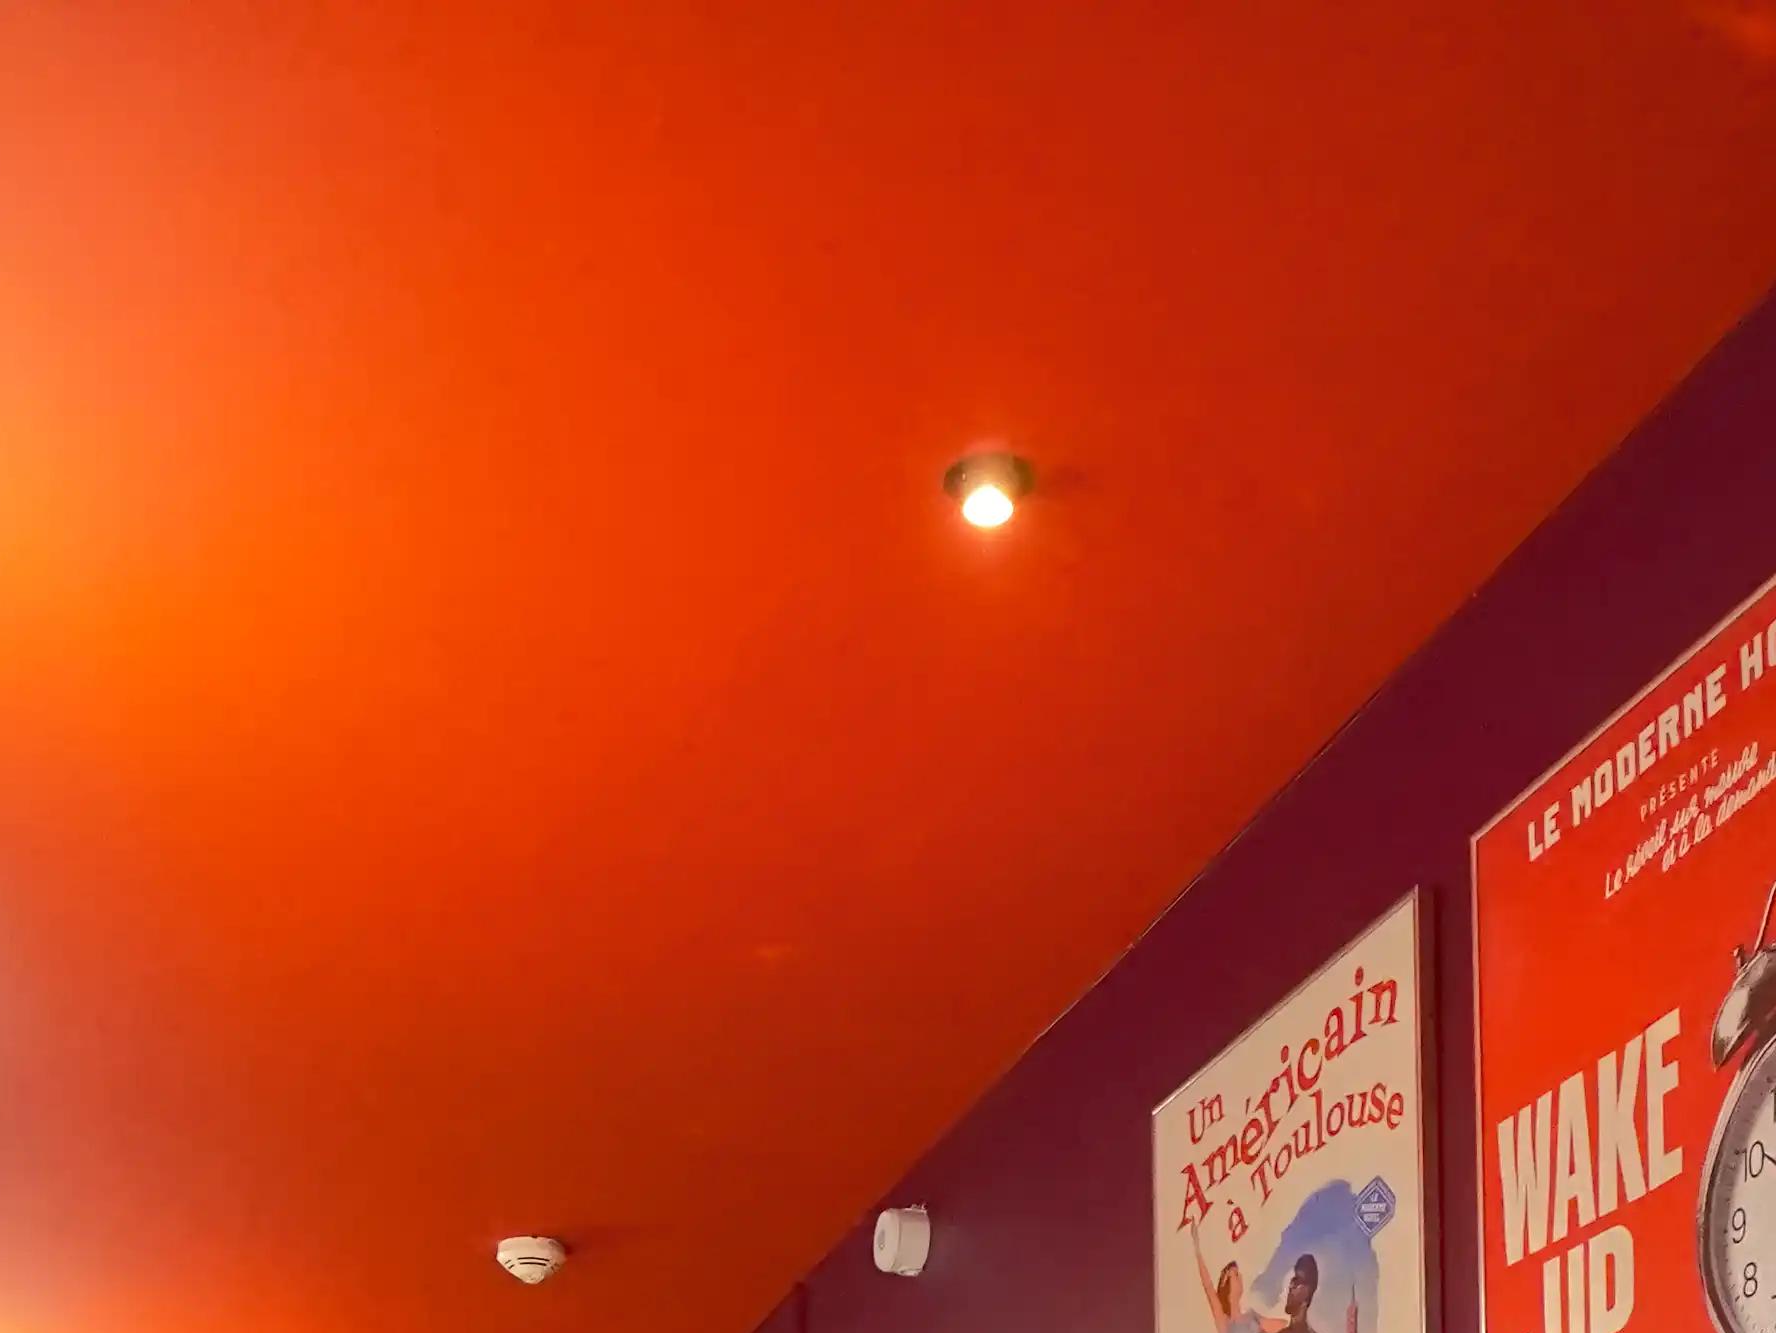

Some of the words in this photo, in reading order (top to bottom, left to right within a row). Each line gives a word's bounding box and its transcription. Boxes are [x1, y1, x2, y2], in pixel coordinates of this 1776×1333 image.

[1527, 801, 1561, 862] LE
[1570, 663, 1727, 828] MODERNE
[1640, 748, 1719, 822] PRÉSENTE
[1176, 966, 1400, 1233] Américain
[1187, 1091, 1224, 1146] Un
[1497, 1006, 1683, 1267] WAKE
[1227, 1199, 1249, 1243] à
[1251, 1081, 1405, 1202] Toulouse
[1743, 1140, 1765, 1183] 10
[1731, 1207, 1746, 1244] 9
[1742, 1261, 1758, 1298] 8
